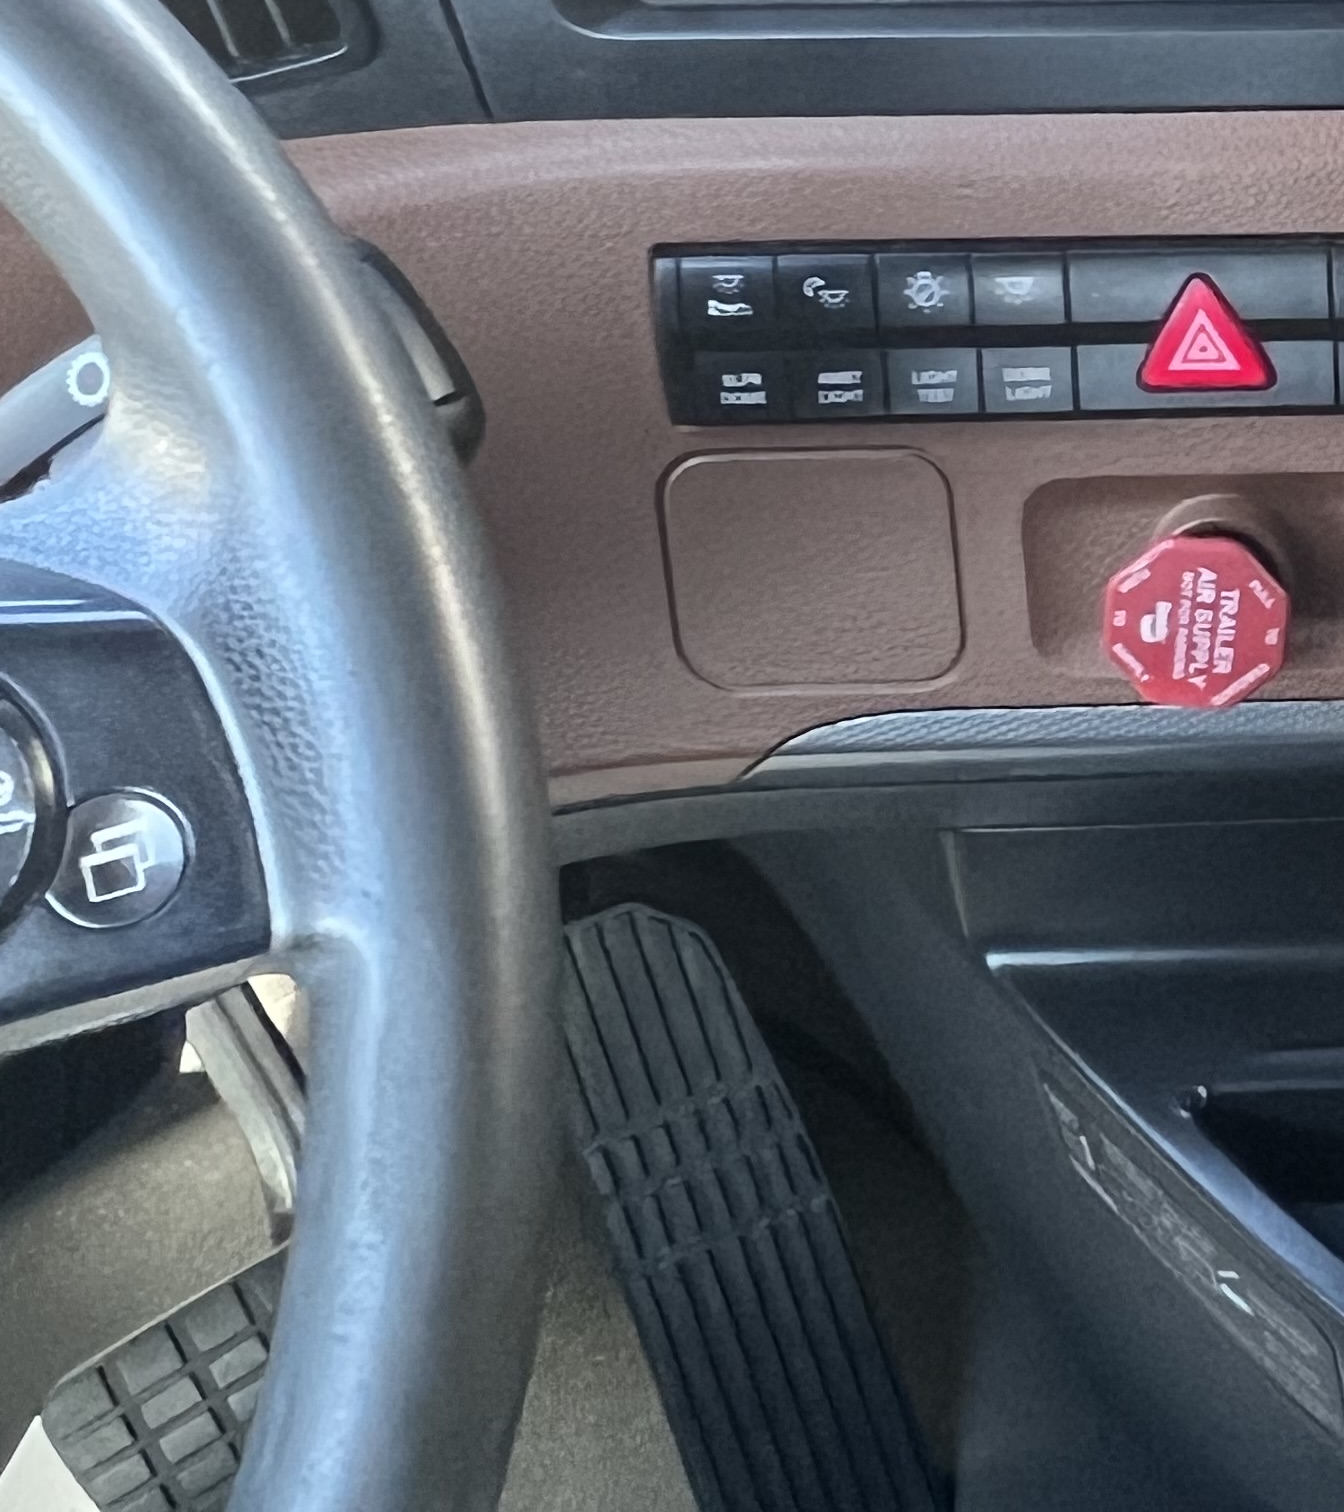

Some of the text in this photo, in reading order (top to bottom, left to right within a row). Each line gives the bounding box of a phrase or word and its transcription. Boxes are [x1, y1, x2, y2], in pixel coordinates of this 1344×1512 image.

[1187, 567, 1218, 691] AIR SUPPLY
[1212, 588, 1241, 675] TRAILER
